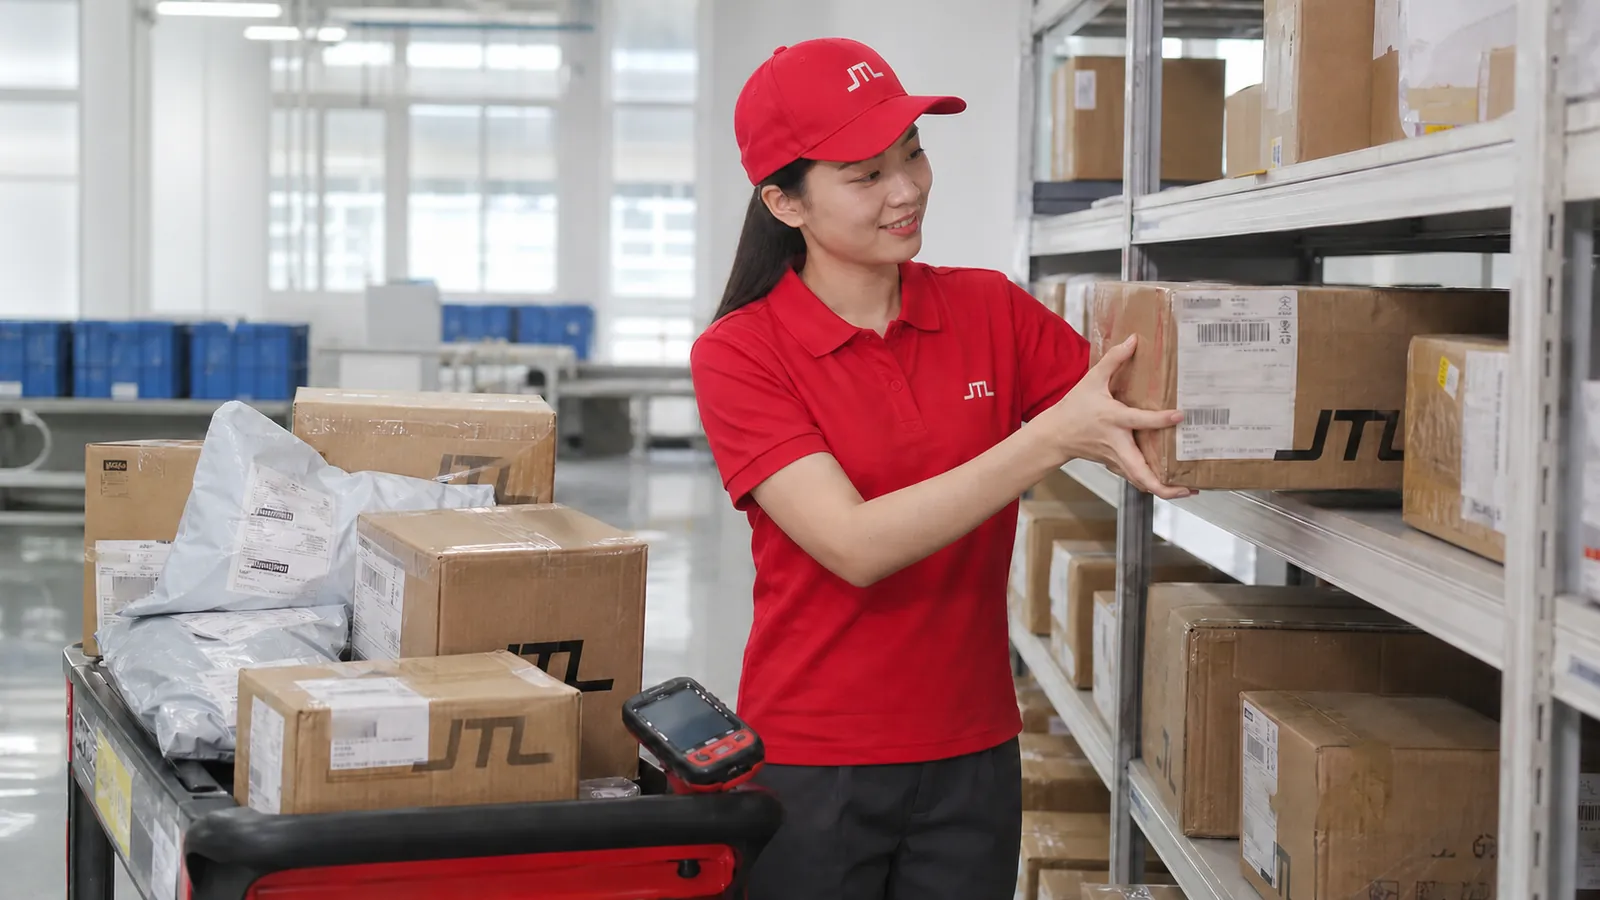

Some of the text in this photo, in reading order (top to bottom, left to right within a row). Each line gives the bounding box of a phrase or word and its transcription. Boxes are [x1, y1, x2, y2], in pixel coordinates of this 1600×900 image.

[847, 61, 884, 93] JTL
[964, 380, 995, 401] JTL
[1273, 409, 1405, 461] JTL
[507, 639, 615, 692] TL
[411, 716, 555, 773] JTL
